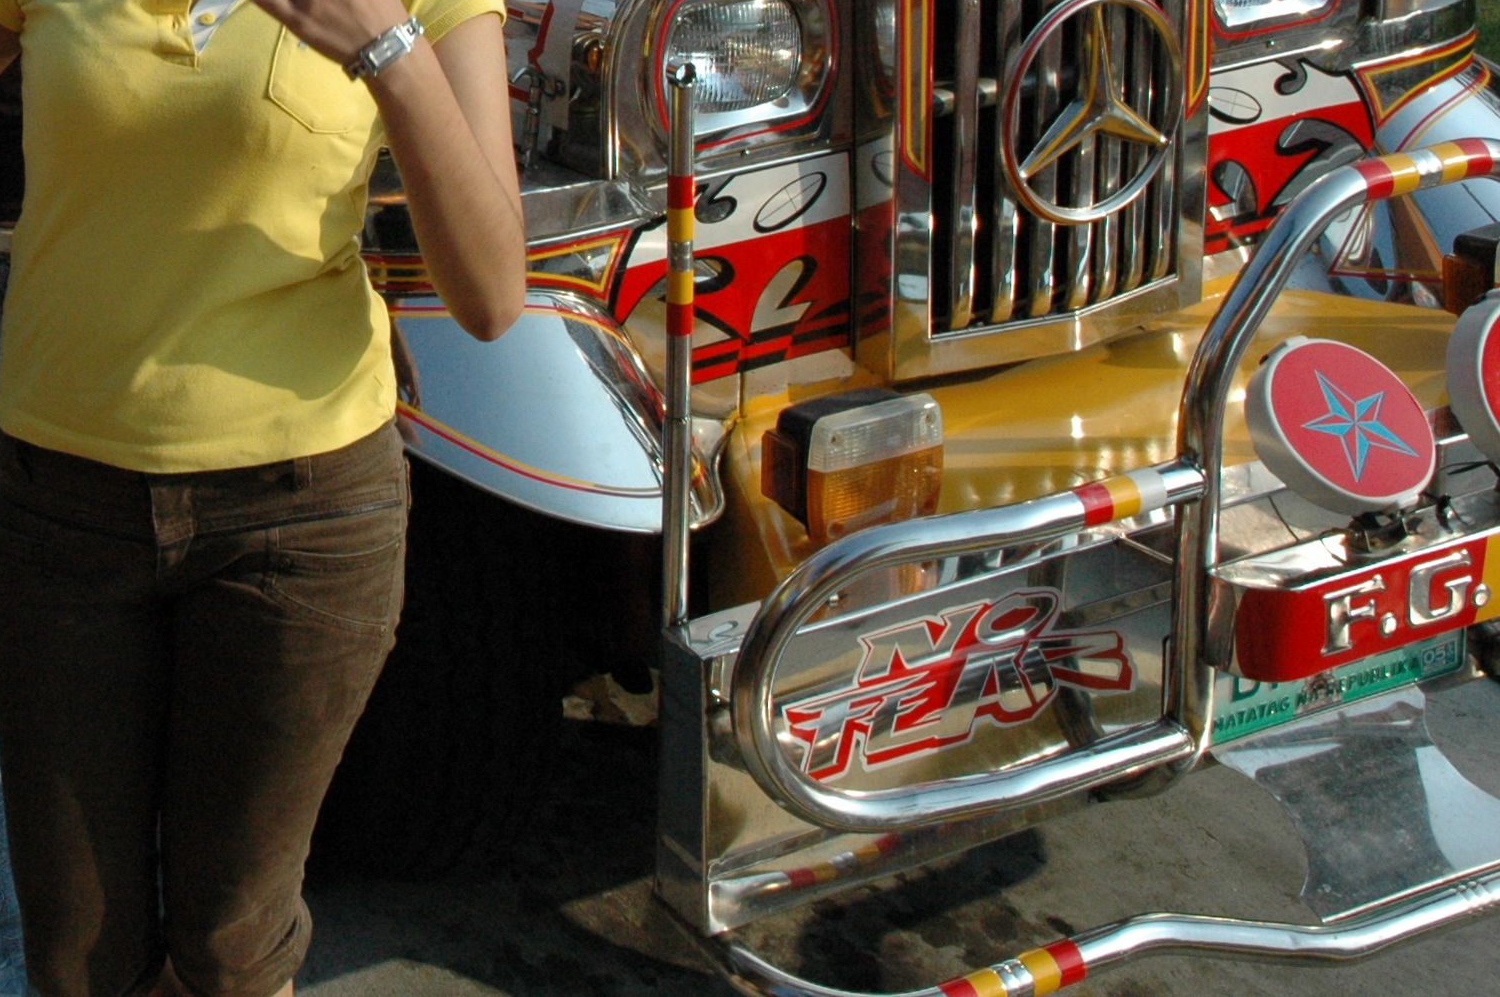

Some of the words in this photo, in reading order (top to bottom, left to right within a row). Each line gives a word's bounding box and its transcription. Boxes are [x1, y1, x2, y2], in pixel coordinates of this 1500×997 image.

[856, 589, 1059, 687] NO
[1321, 549, 1491, 656] F.G.
[784, 630, 1134, 781] FEAR
